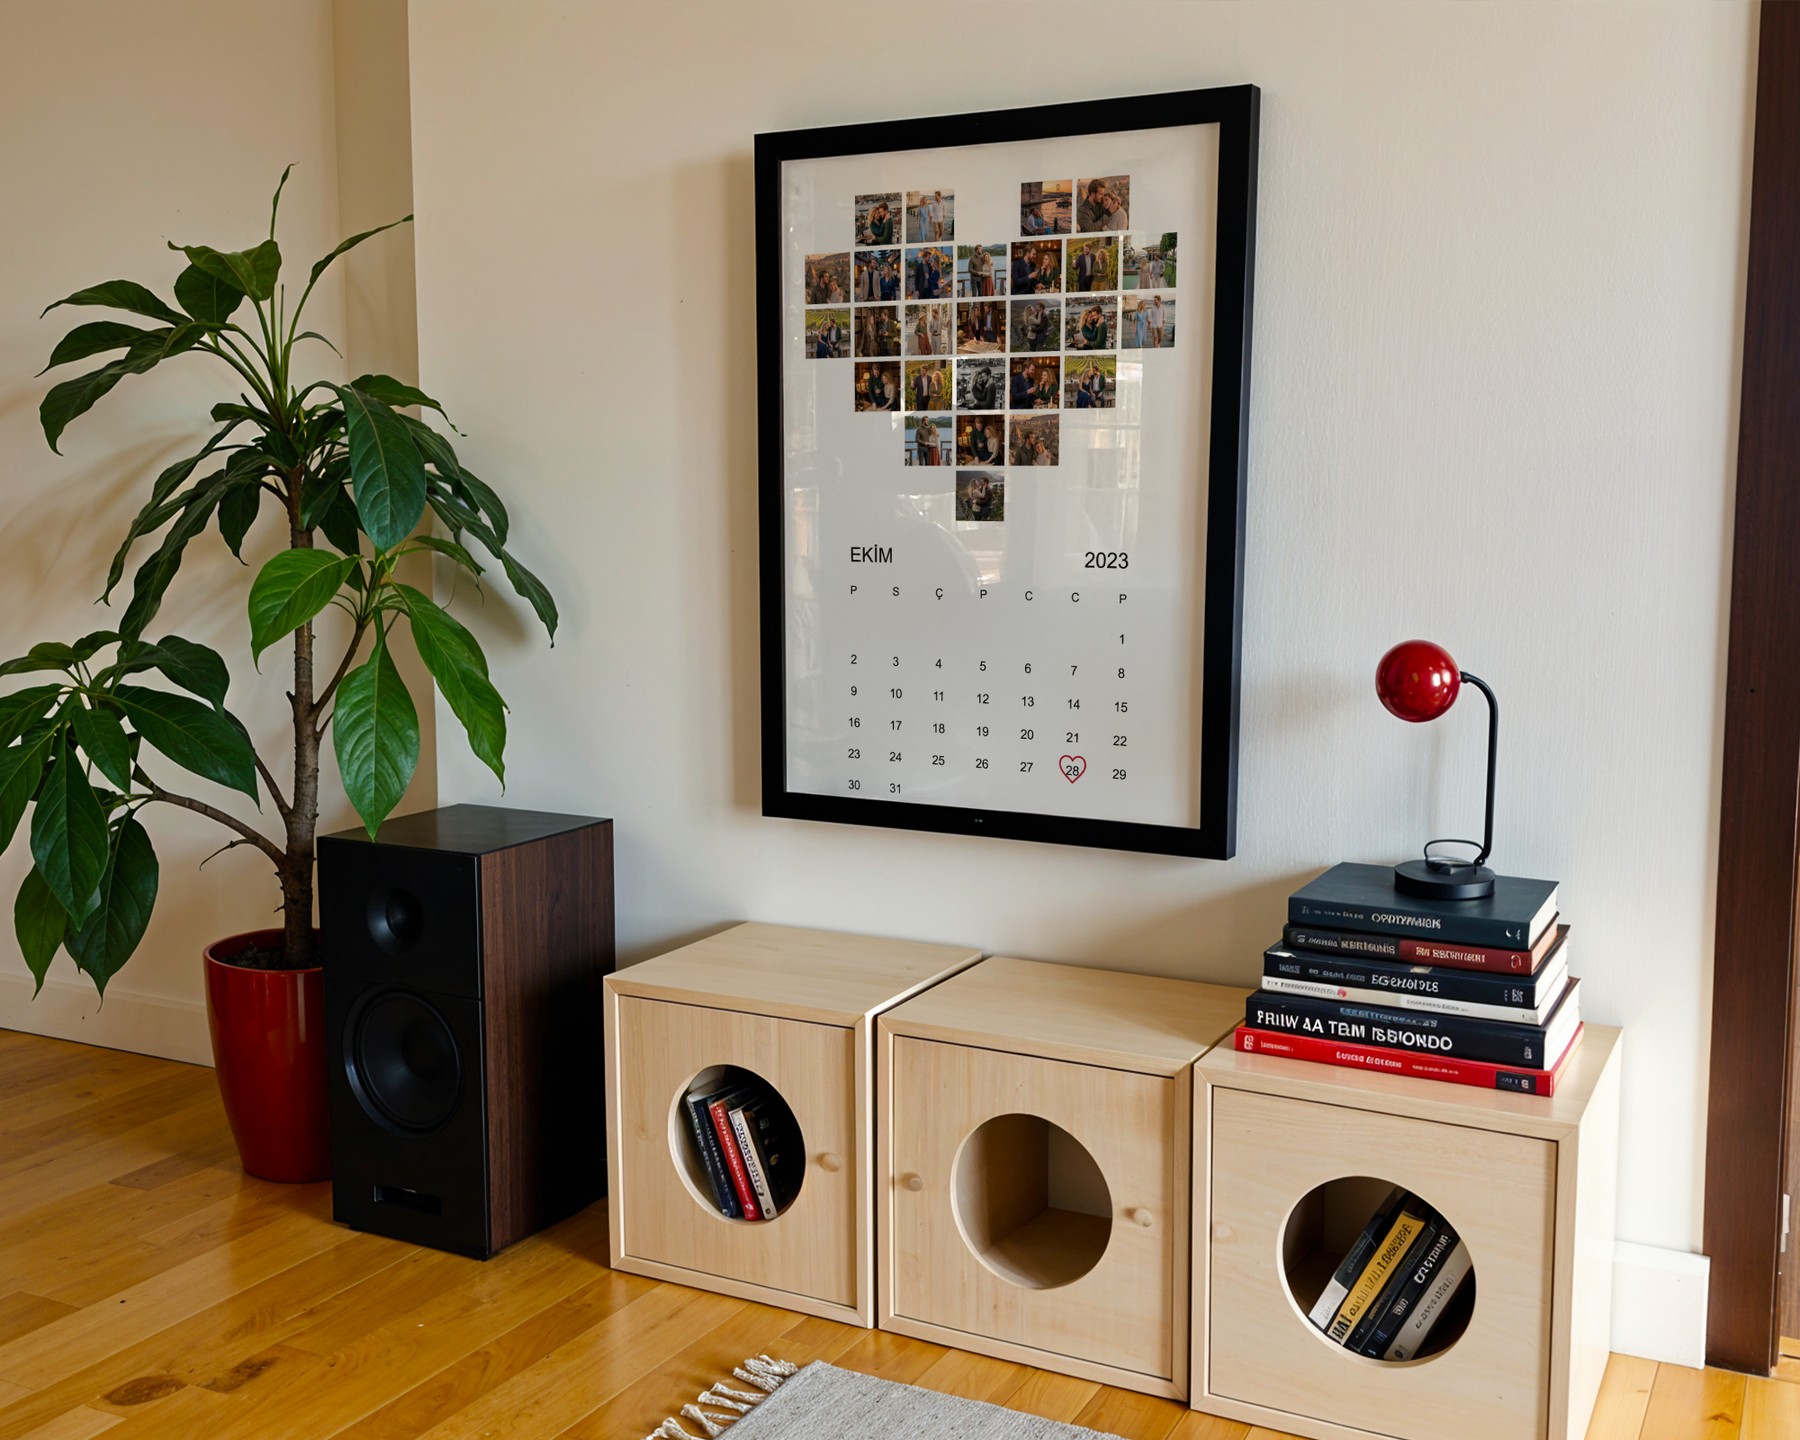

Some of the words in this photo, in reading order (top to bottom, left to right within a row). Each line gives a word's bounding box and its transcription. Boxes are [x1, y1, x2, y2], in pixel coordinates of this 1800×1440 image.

[850, 543, 893, 564] EKİM
[1084, 551, 1129, 570] 2023
[850, 585, 858, 595] P
[892, 586, 900, 597] S
[935, 587, 944, 601] Ç
[979, 589, 988, 600] P
[1024, 590, 1033, 602] C
[1071, 591, 1080, 603] C
[1118, 593, 1128, 604] P
[1119, 633, 1125, 645] 1
[850, 653, 858, 665] 2
[892, 656, 900, 667] 3
[935, 658, 943, 669] 4
[979, 660, 987, 672] 5
[1024, 662, 1032, 674] 6
[1070, 665, 1078, 677] 7
[1117, 667, 1126, 679] 8
[850, 685, 858, 697] 9
[890, 687, 903, 700] 10
[933, 690, 944, 702] 11
[976, 693, 990, 705] 12
[1021, 695, 1035, 708] 13
[1067, 698, 1081, 710] 14
[1114, 701, 1128, 713] 15
[848, 717, 861, 728] 16
[890, 719, 903, 731] 17
[932, 722, 946, 735] 18
[976, 725, 990, 738] 19
[1020, 728, 1035, 741] 20
[1065, 731, 1079, 744] 21
[1112, 734, 1128, 747] 22
[847, 748, 861, 760] 23
[889, 751, 903, 763] 24
[931, 754, 946, 766] 25
[975, 757, 989, 770] 26
[1019, 761, 1034, 773] 27
[1065, 765, 1080, 777] 28
[1112, 768, 1127, 781] 29
[848, 779, 861, 791] 30
[889, 782, 901, 794] 31
